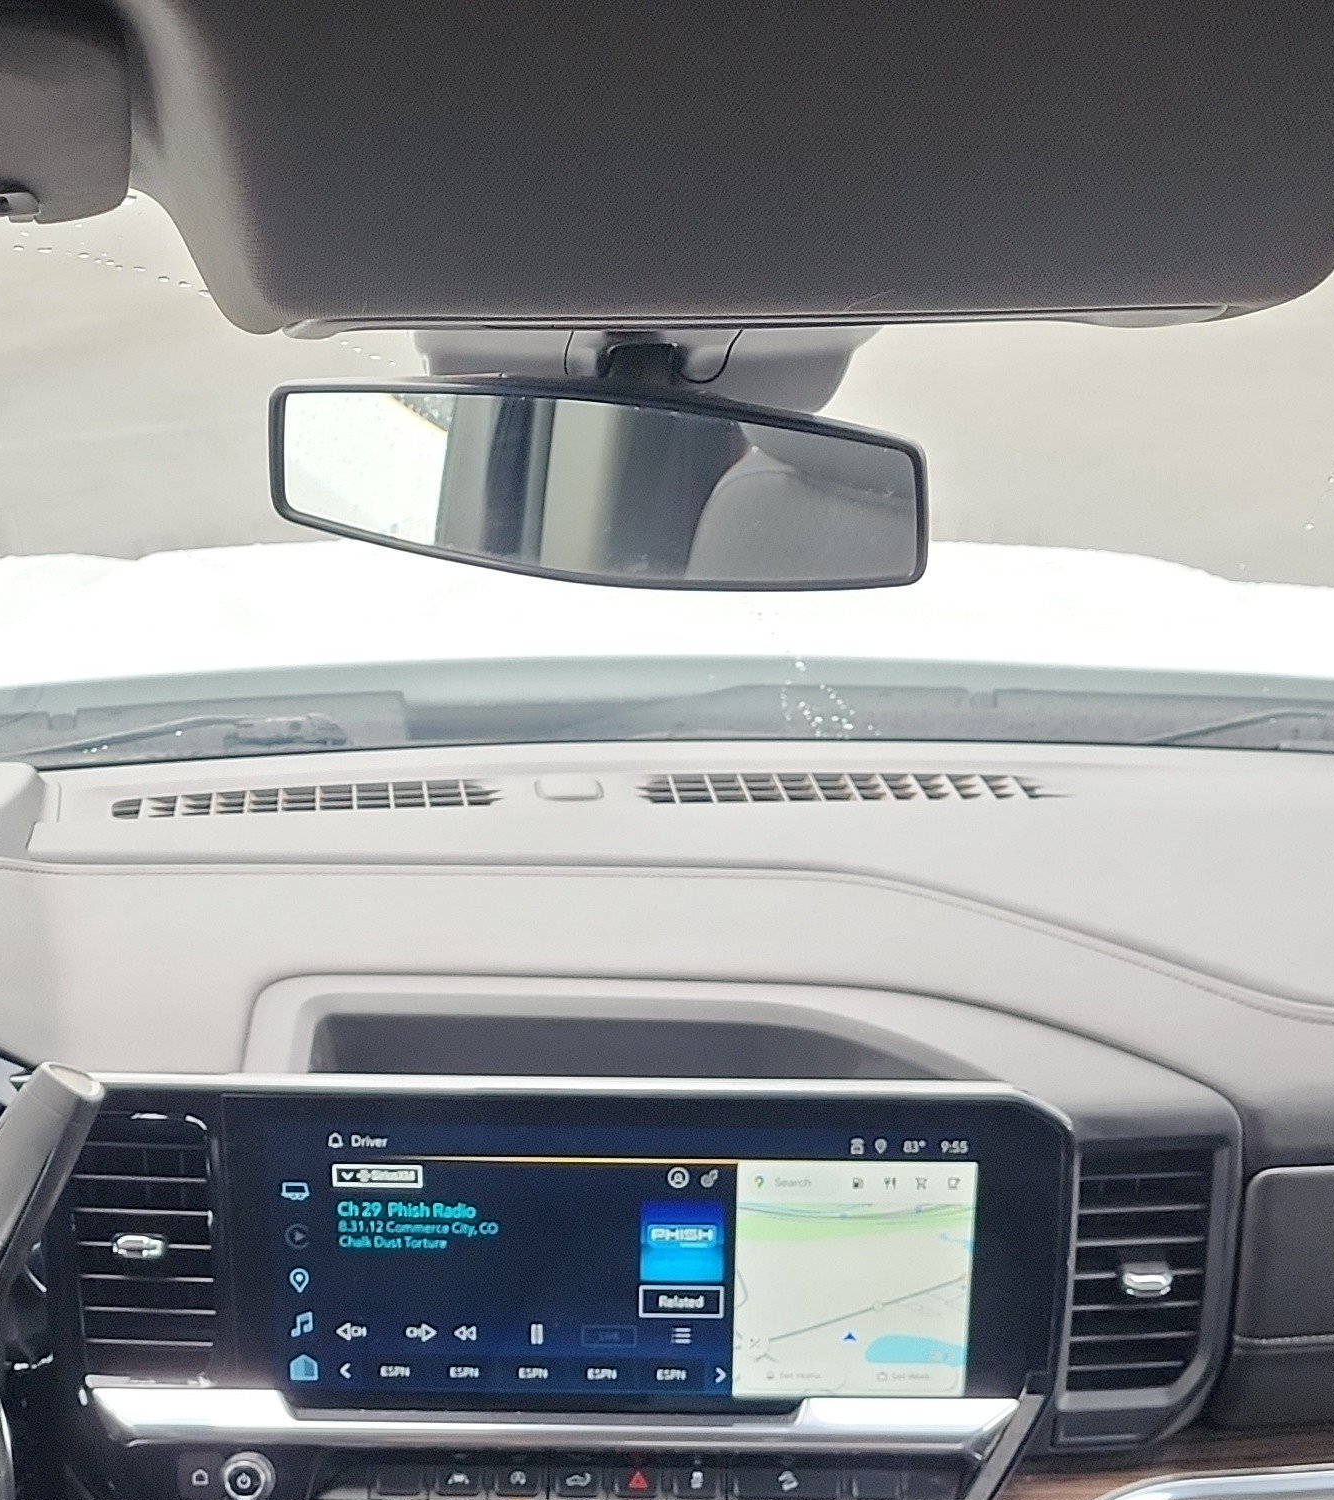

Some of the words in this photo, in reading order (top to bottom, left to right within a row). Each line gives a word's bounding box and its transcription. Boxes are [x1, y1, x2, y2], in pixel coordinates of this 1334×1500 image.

[351, 1135, 388, 1148] Driver
[941, 1141, 969, 1154] 9:55
[774, 1177, 811, 1188] Search
[337, 1201, 359, 1217] Ch
[361, 1201, 382, 1217] 29
[387, 1202, 431, 1218] Phish
[432, 1202, 477, 1219] Radio
[385, 1221, 450, 1234] Commerce
[479, 1221, 499, 1235] CO
[338, 1235, 372, 1248] Chalk
[374, 1236, 402, 1248] Dust
[404, 1236, 448, 1249] Torture
[658, 1295, 705, 1308] Related
[380, 1366, 410, 1378] ESPN
[449, 1366, 480, 1378] ESPN
[518, 1367, 549, 1379] ESPN
[586, 1367, 617, 1380] ESPN
[656, 1368, 687, 1381] ESPN
